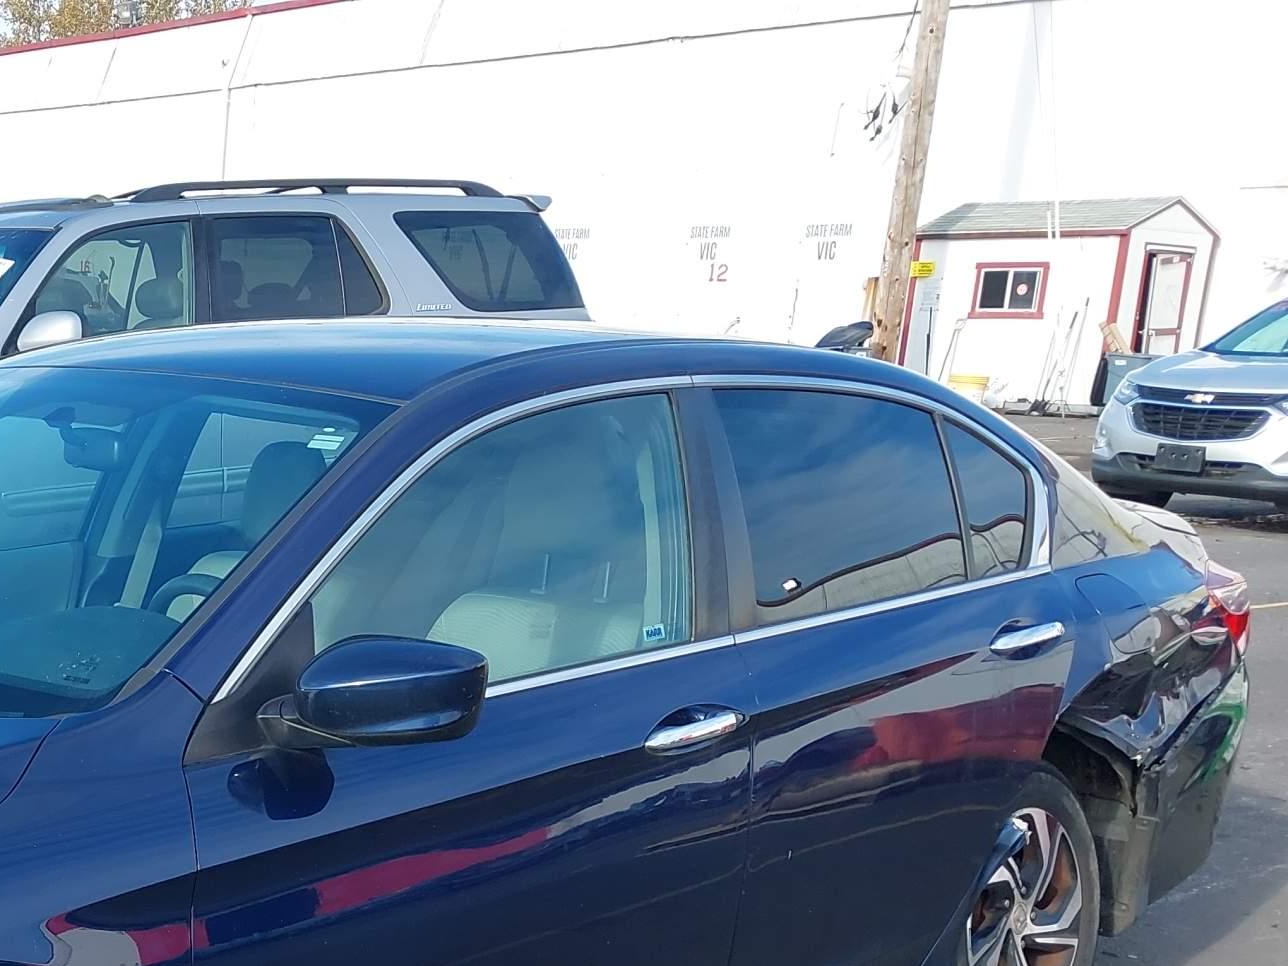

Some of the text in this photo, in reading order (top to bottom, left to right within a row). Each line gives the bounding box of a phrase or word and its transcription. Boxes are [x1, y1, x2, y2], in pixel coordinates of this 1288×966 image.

[573, 228, 590, 239] FARM
[690, 225, 731, 239] STATE FARM
[805, 223, 853, 238] STATE FARM
[699, 242, 718, 261] VIC
[817, 241, 837, 260] VIC
[708, 263, 729, 282] 12
